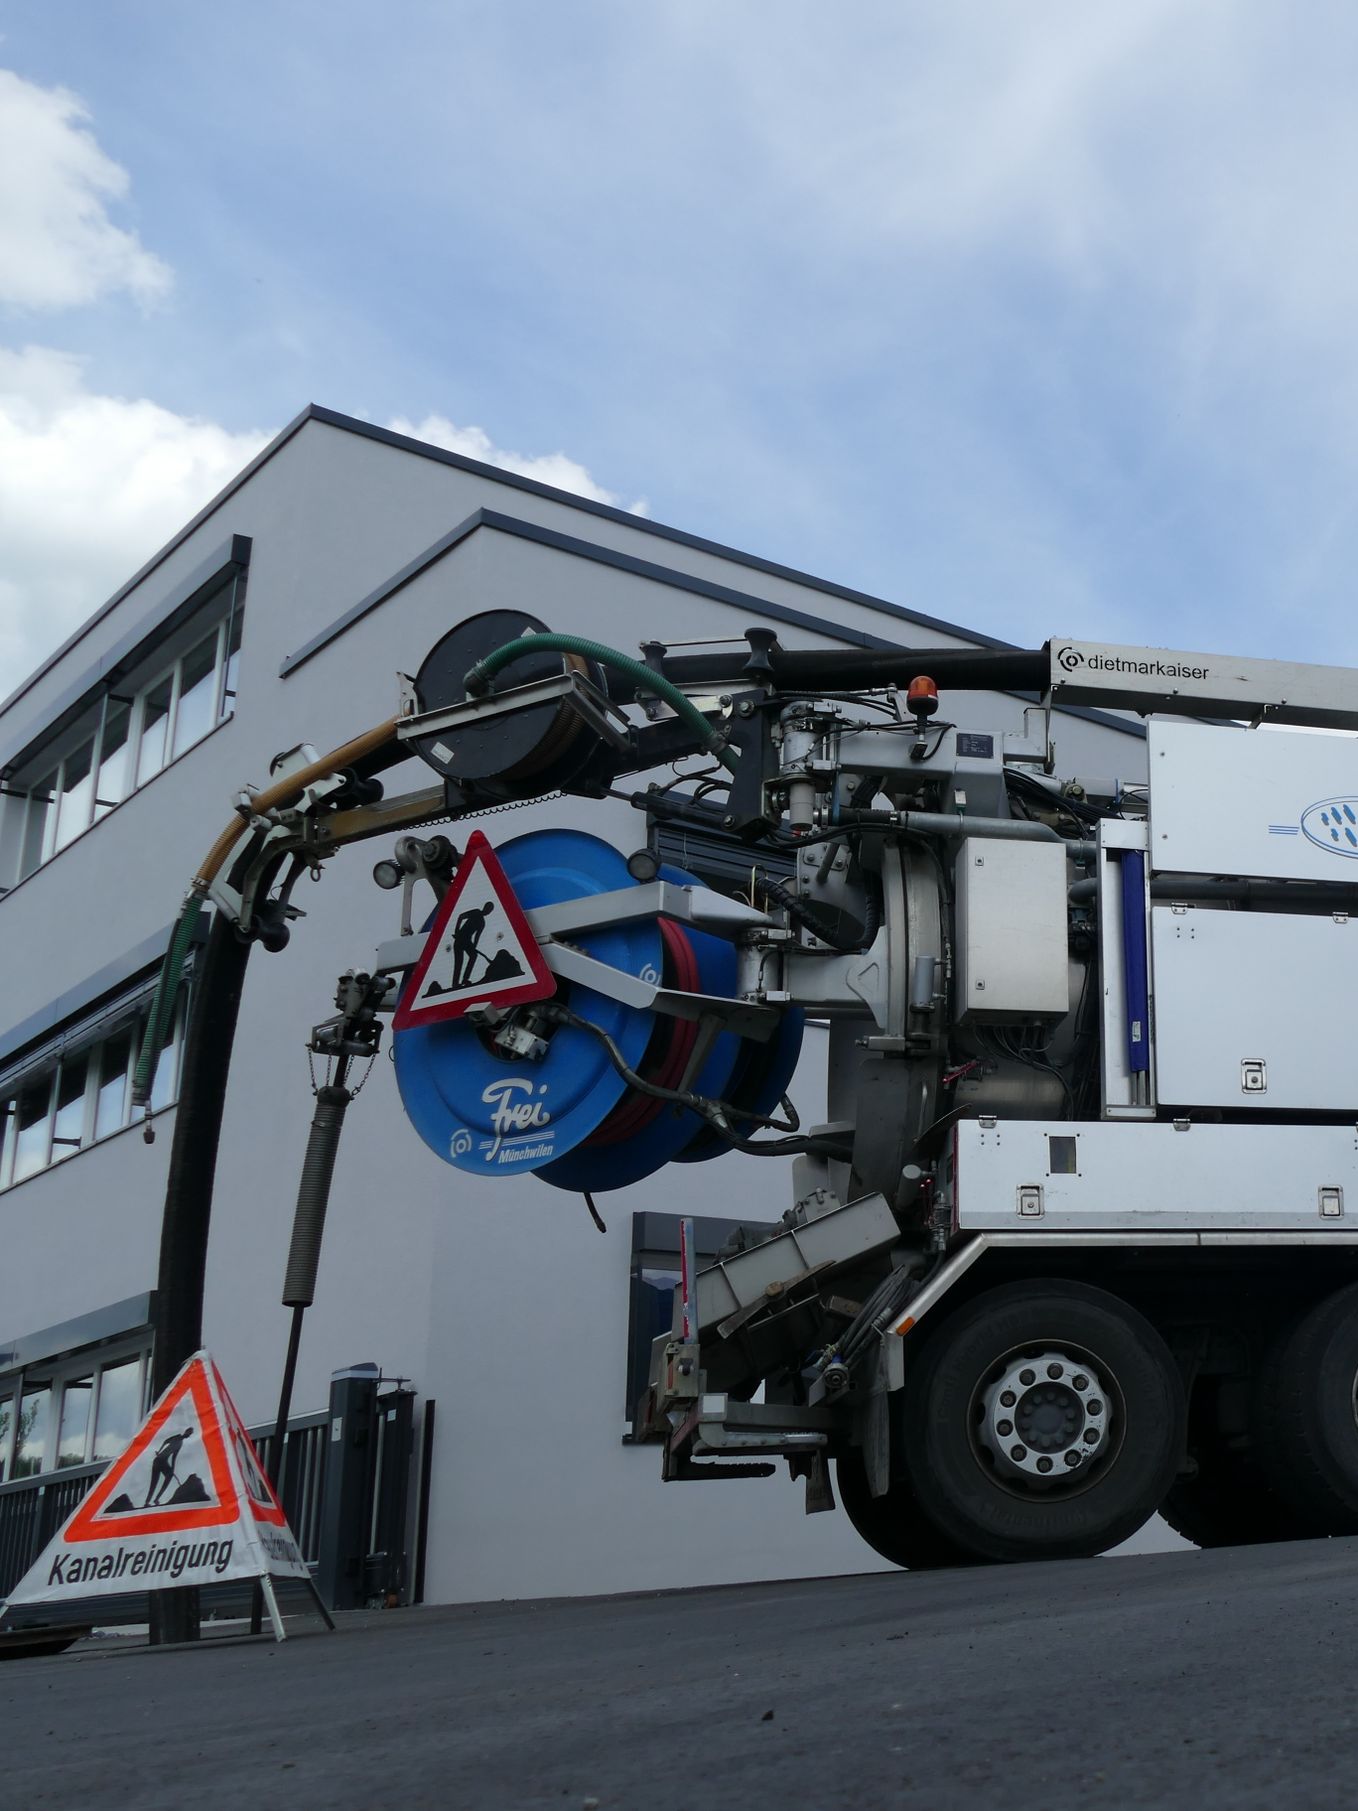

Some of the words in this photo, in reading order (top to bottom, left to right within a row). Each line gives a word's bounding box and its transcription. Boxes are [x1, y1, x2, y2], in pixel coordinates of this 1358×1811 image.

[1088, 655, 1209, 680] dietmarkaiser
[482, 1077, 551, 1161] Frei
[498, 1143, 554, 1164] Münchwilen
[48, 1539, 234, 1586] Kanalreinigung
